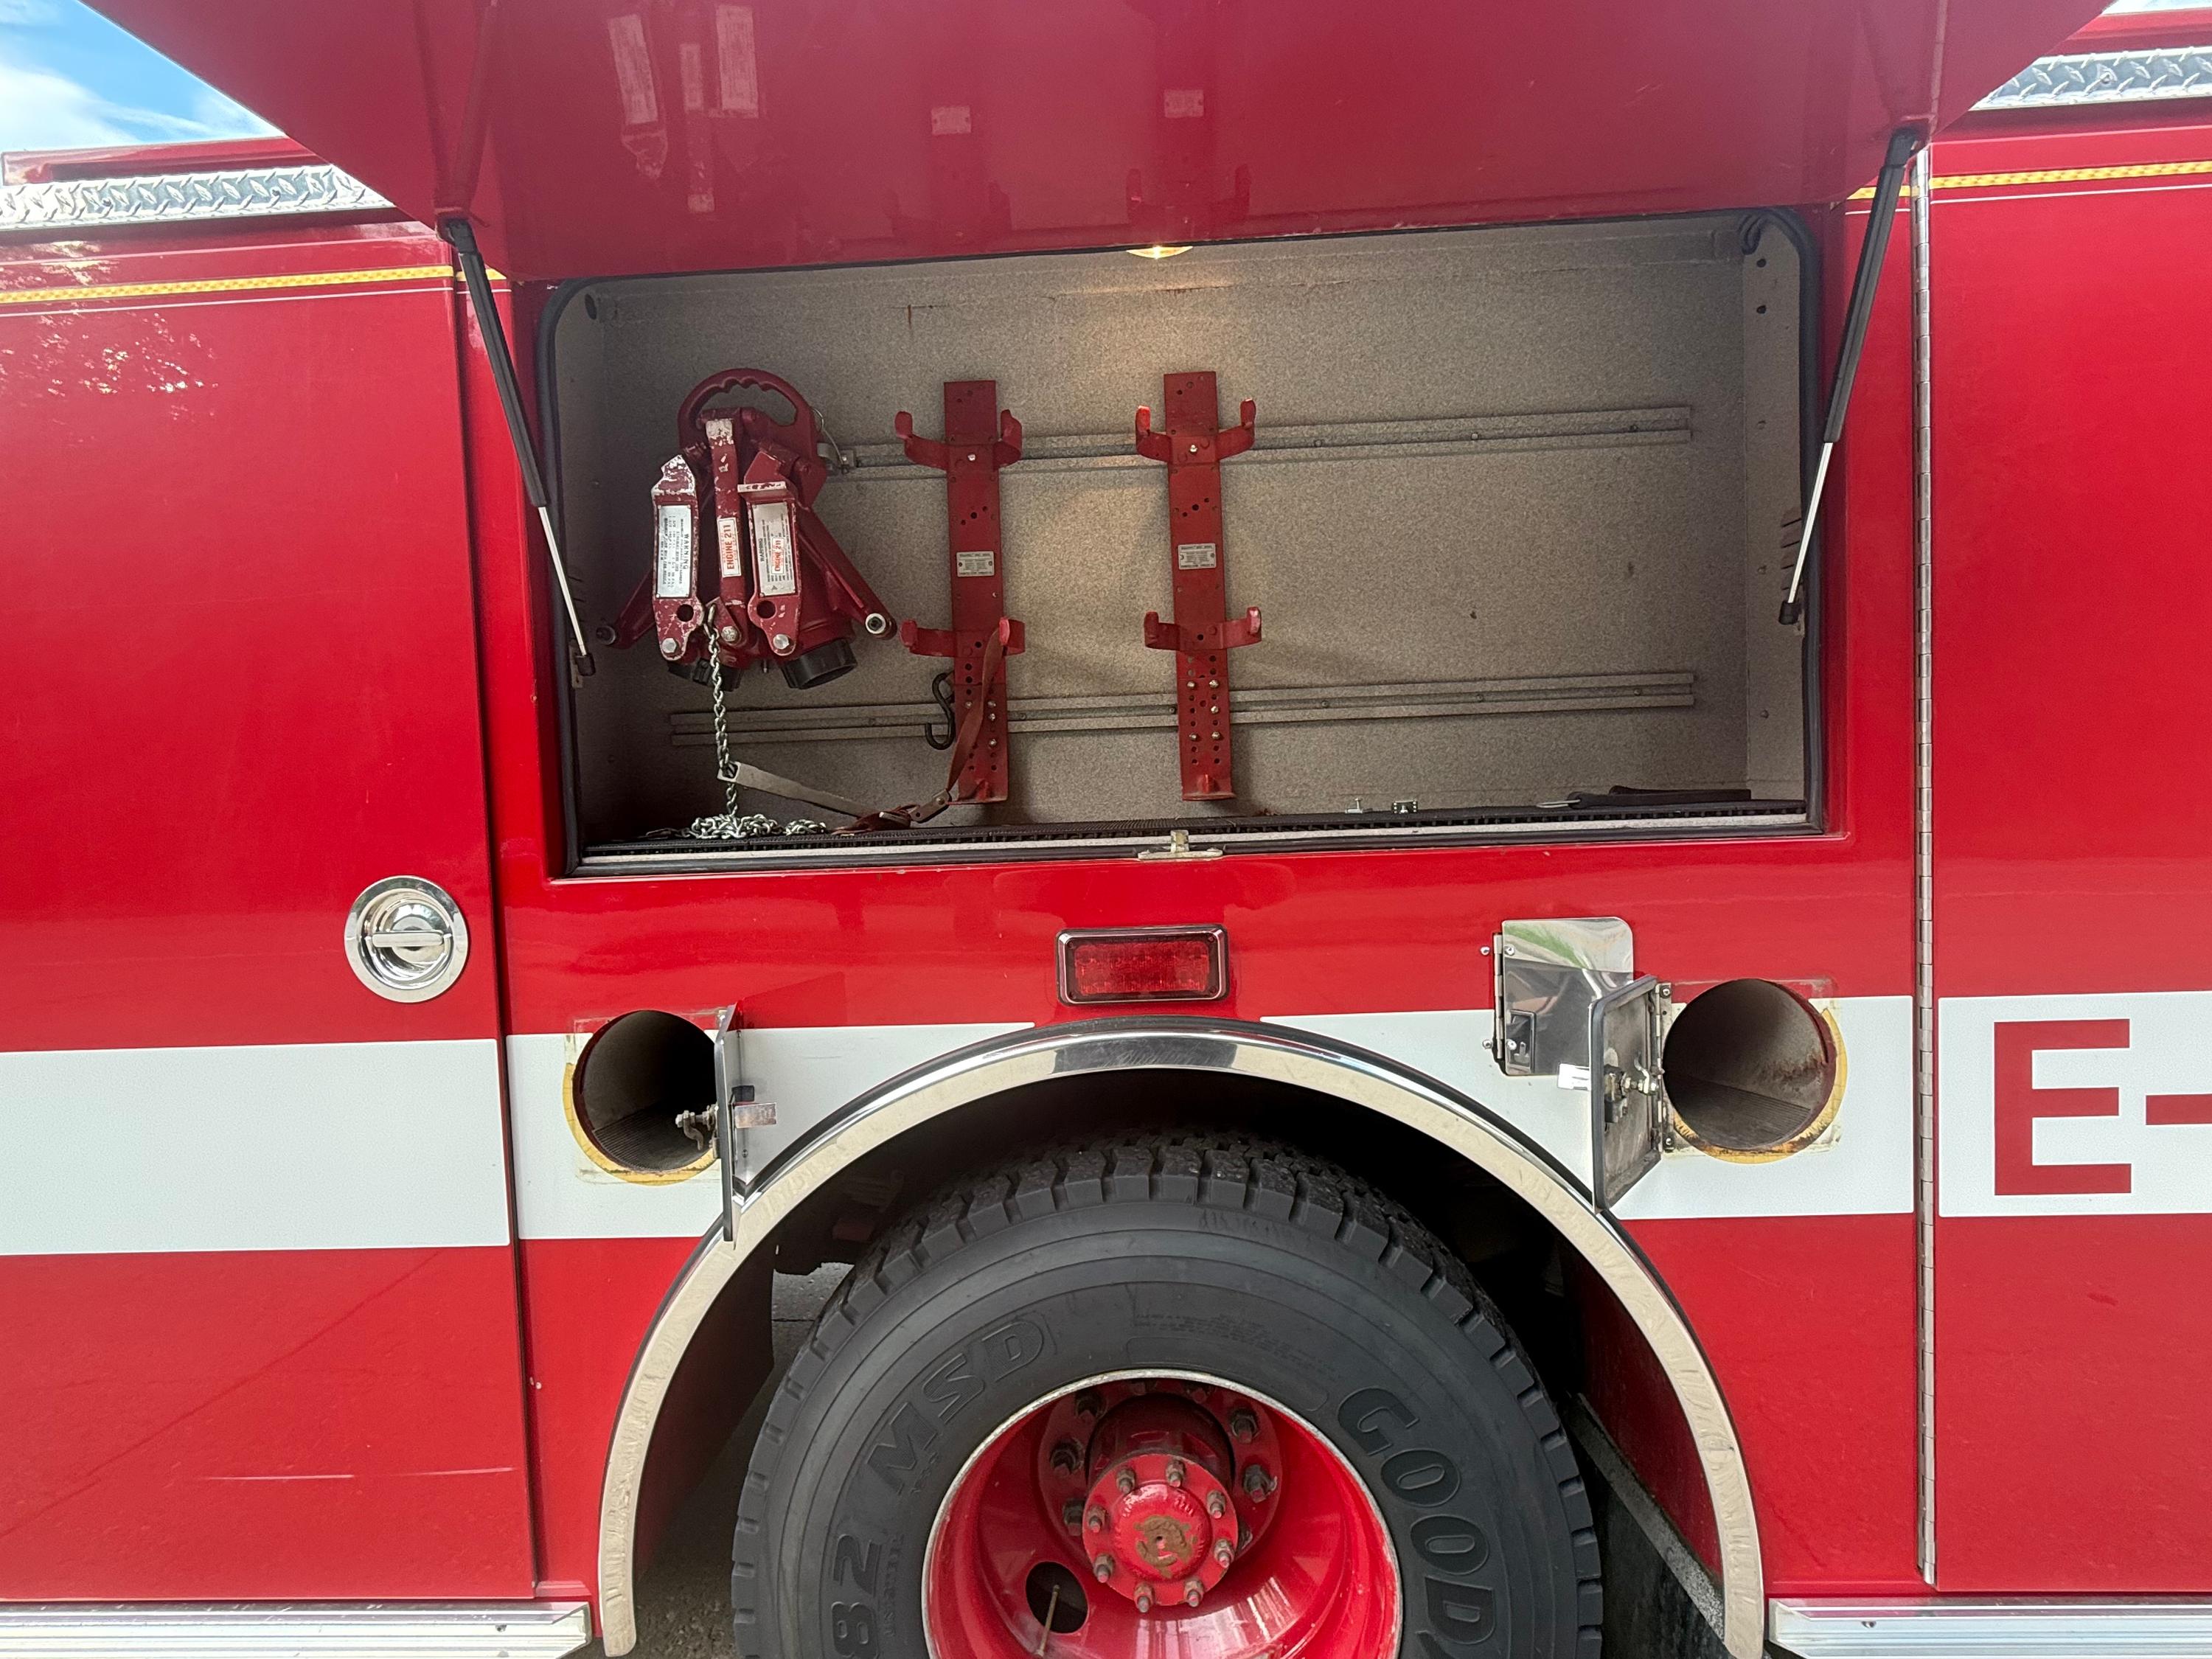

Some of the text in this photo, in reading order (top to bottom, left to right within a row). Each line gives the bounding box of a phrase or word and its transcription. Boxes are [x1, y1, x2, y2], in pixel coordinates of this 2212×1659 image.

[723, 524, 732, 538] 211
[725, 540, 735, 570] ENGINE
[866, 1319, 1045, 1495] MSD
